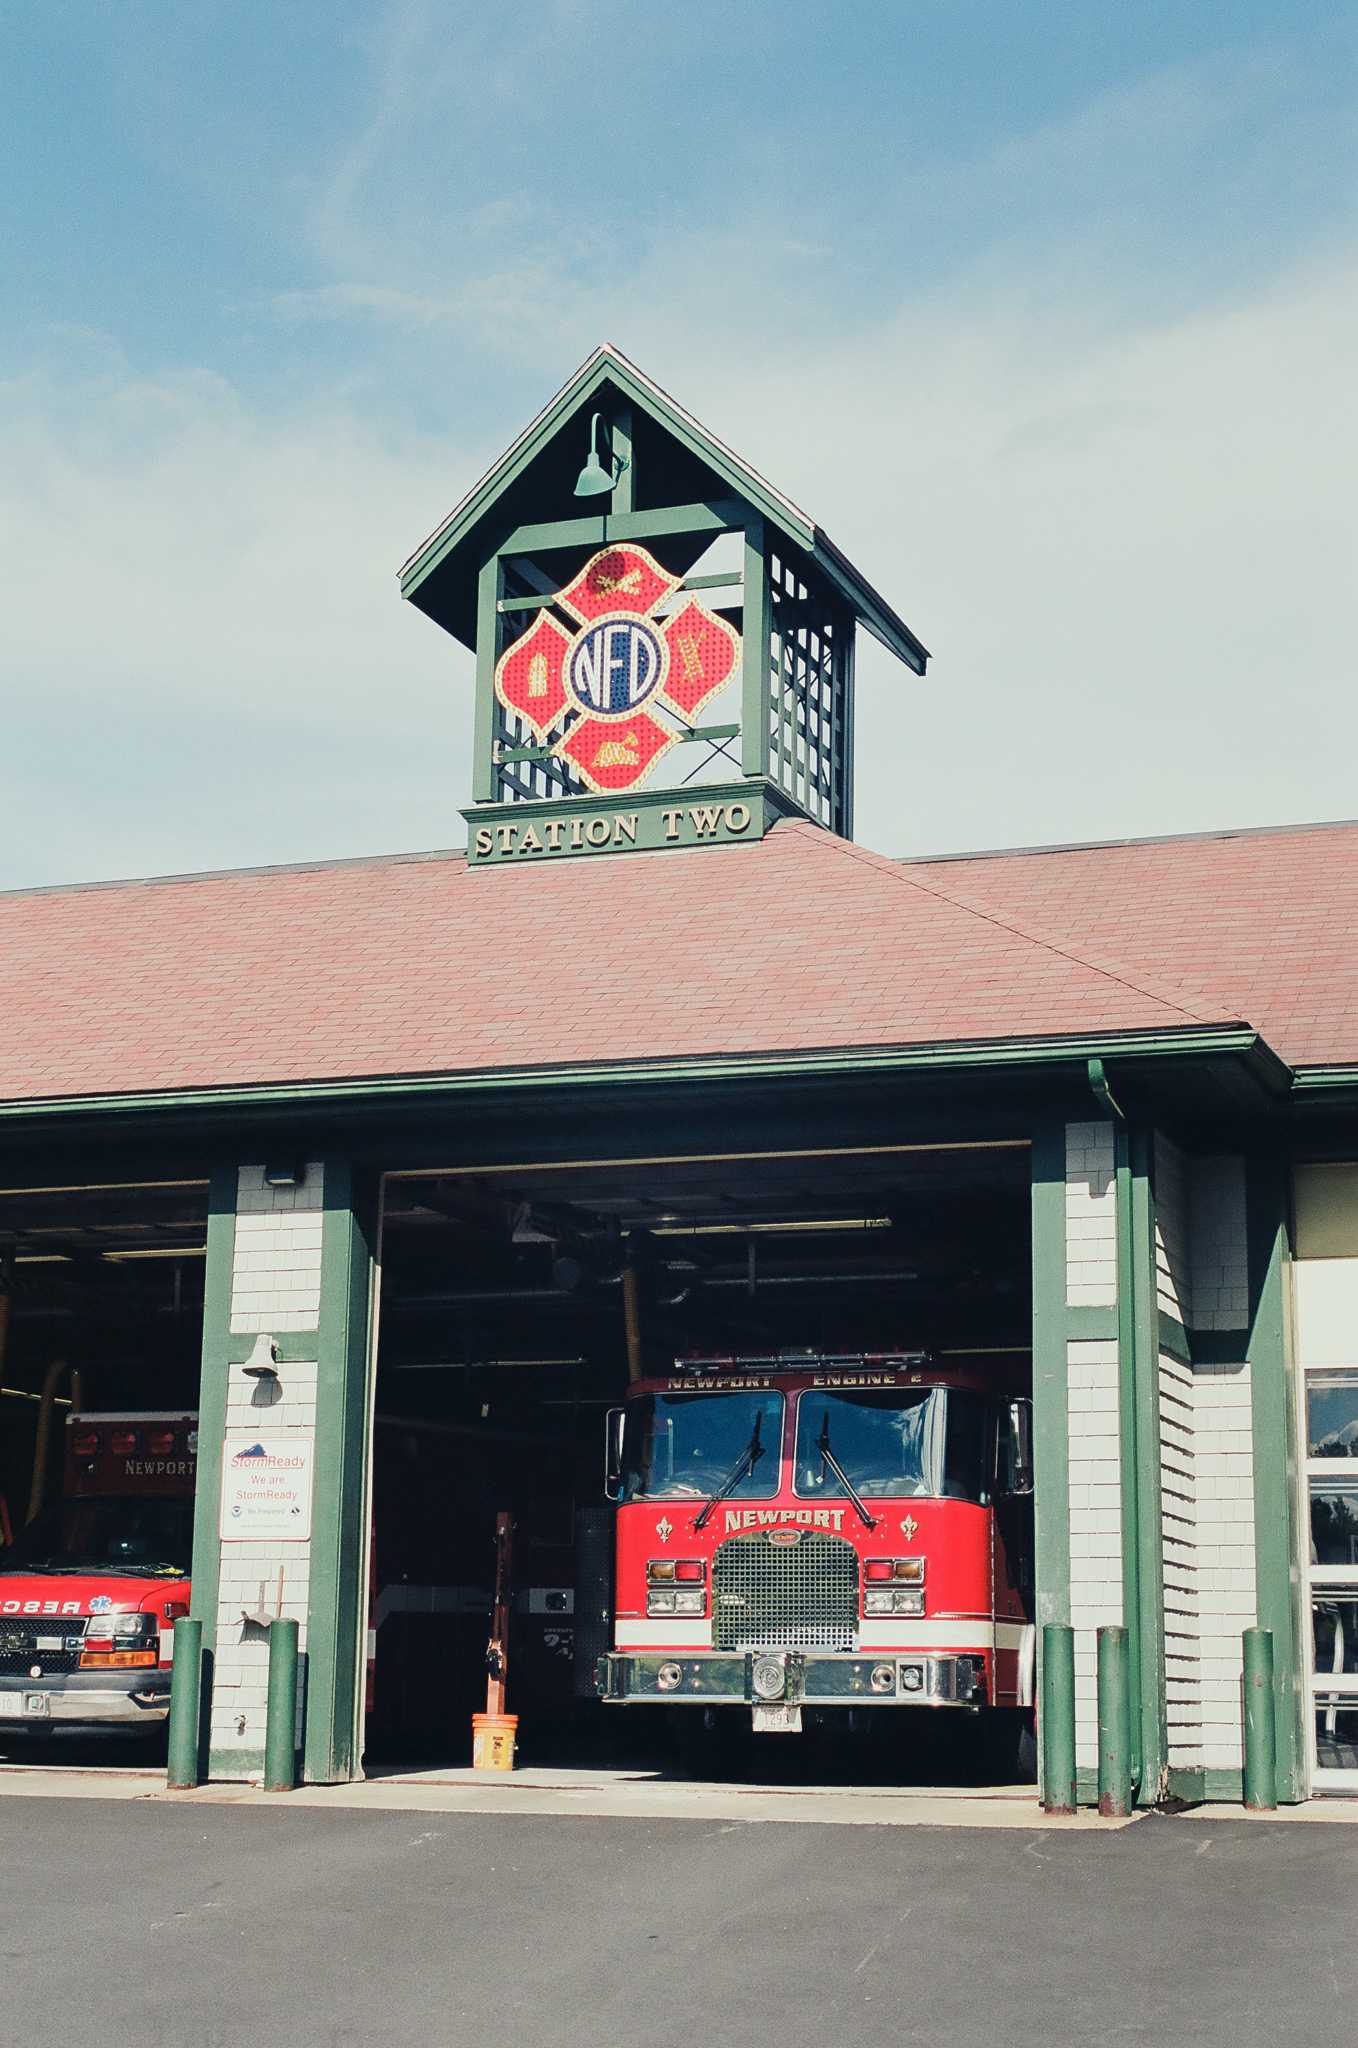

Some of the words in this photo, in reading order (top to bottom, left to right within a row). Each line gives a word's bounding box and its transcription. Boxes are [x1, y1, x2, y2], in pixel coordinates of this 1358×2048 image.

[575, 624, 657, 708] NFD
[476, 814, 638, 855] STATION
[662, 805, 751, 838] TWO
[668, 1376, 773, 1389] NEWPORT
[813, 1374, 896, 1386] ENGINE
[126, 1460, 195, 1475] NEWPORT
[231, 1455, 306, 1468] StormReady
[250, 1475, 266, 1485] We
[235, 1489, 298, 1501] StormReady
[725, 1510, 846, 1534] NEWPORT
